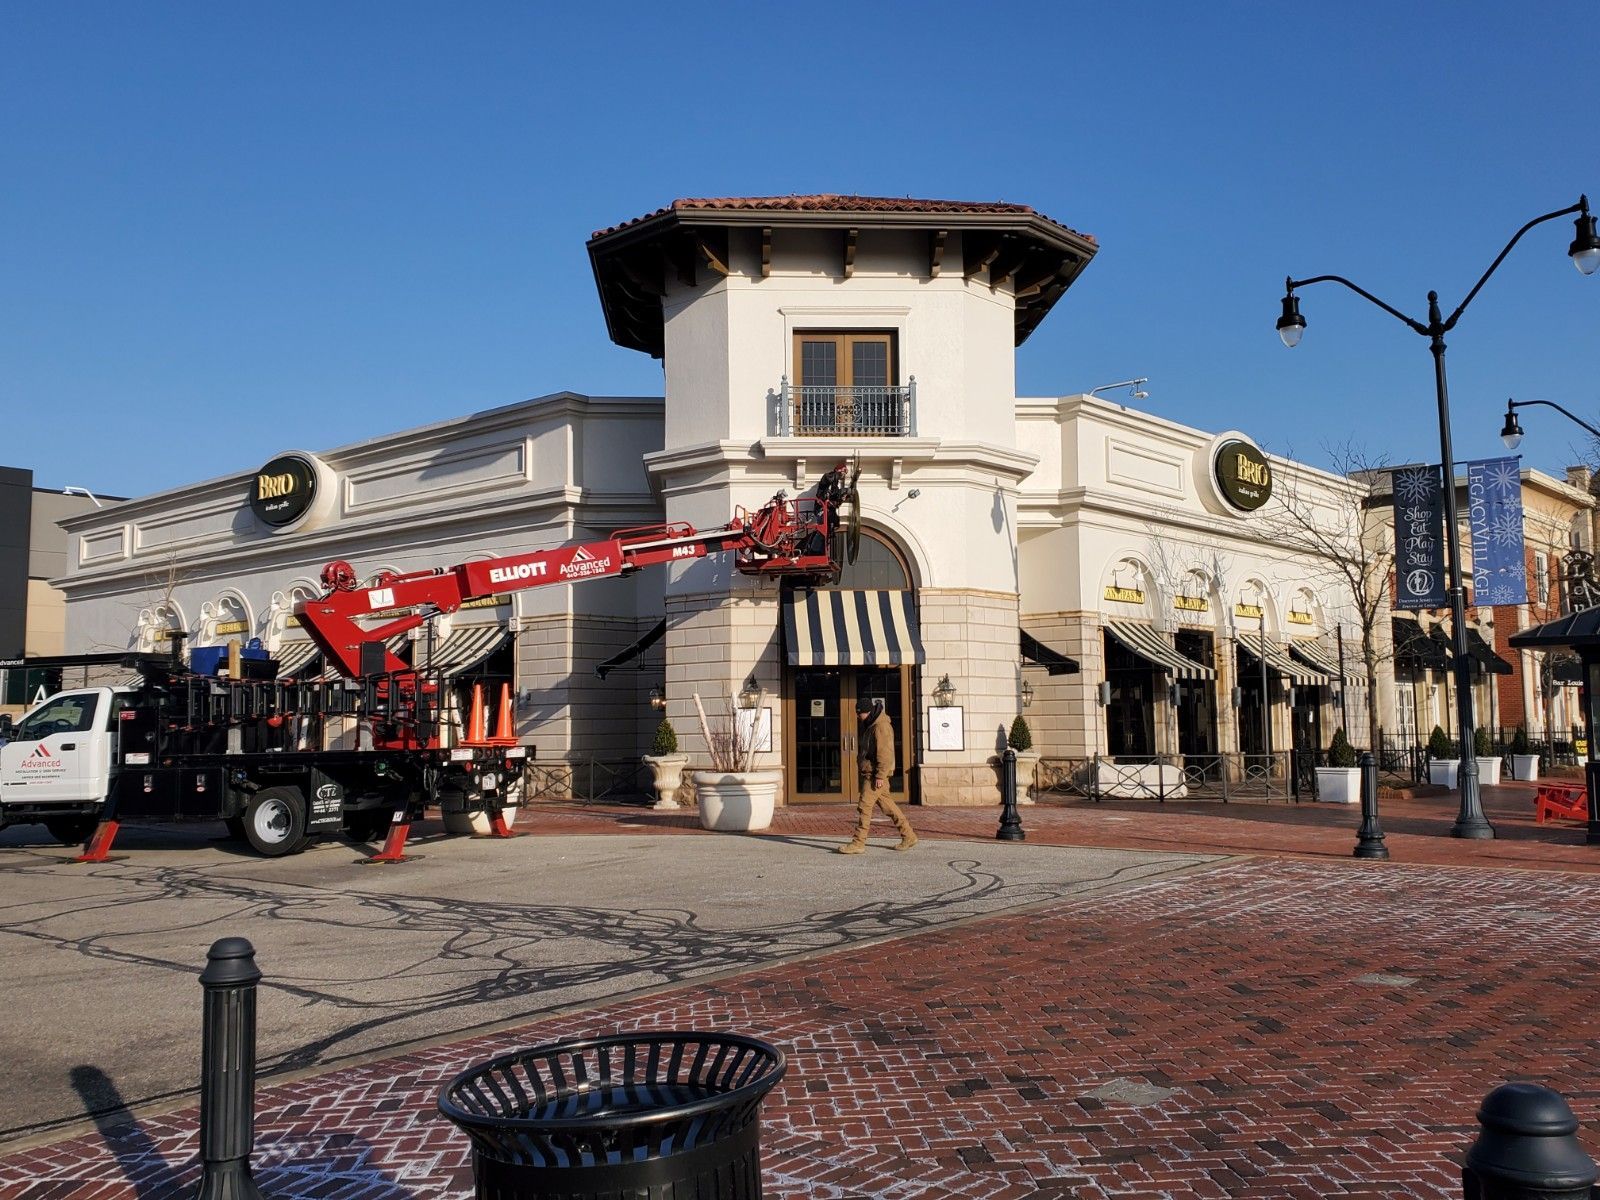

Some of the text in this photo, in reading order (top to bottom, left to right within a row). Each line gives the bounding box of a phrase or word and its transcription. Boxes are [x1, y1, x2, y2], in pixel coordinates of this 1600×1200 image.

[1236, 453, 1268, 486] BRIO
[257, 473, 294, 500] BRIO
[1404, 505, 1432, 522] Shop
[1410, 521, 1431, 536] Eat
[672, 544, 695, 557] M43
[1404, 537, 1434, 553] Play
[559, 556, 611, 575] Advanced
[1406, 551, 1433, 567] Stay
[488, 561, 548, 584] ELLIOTT
[21, 759, 62, 768] Advanced
